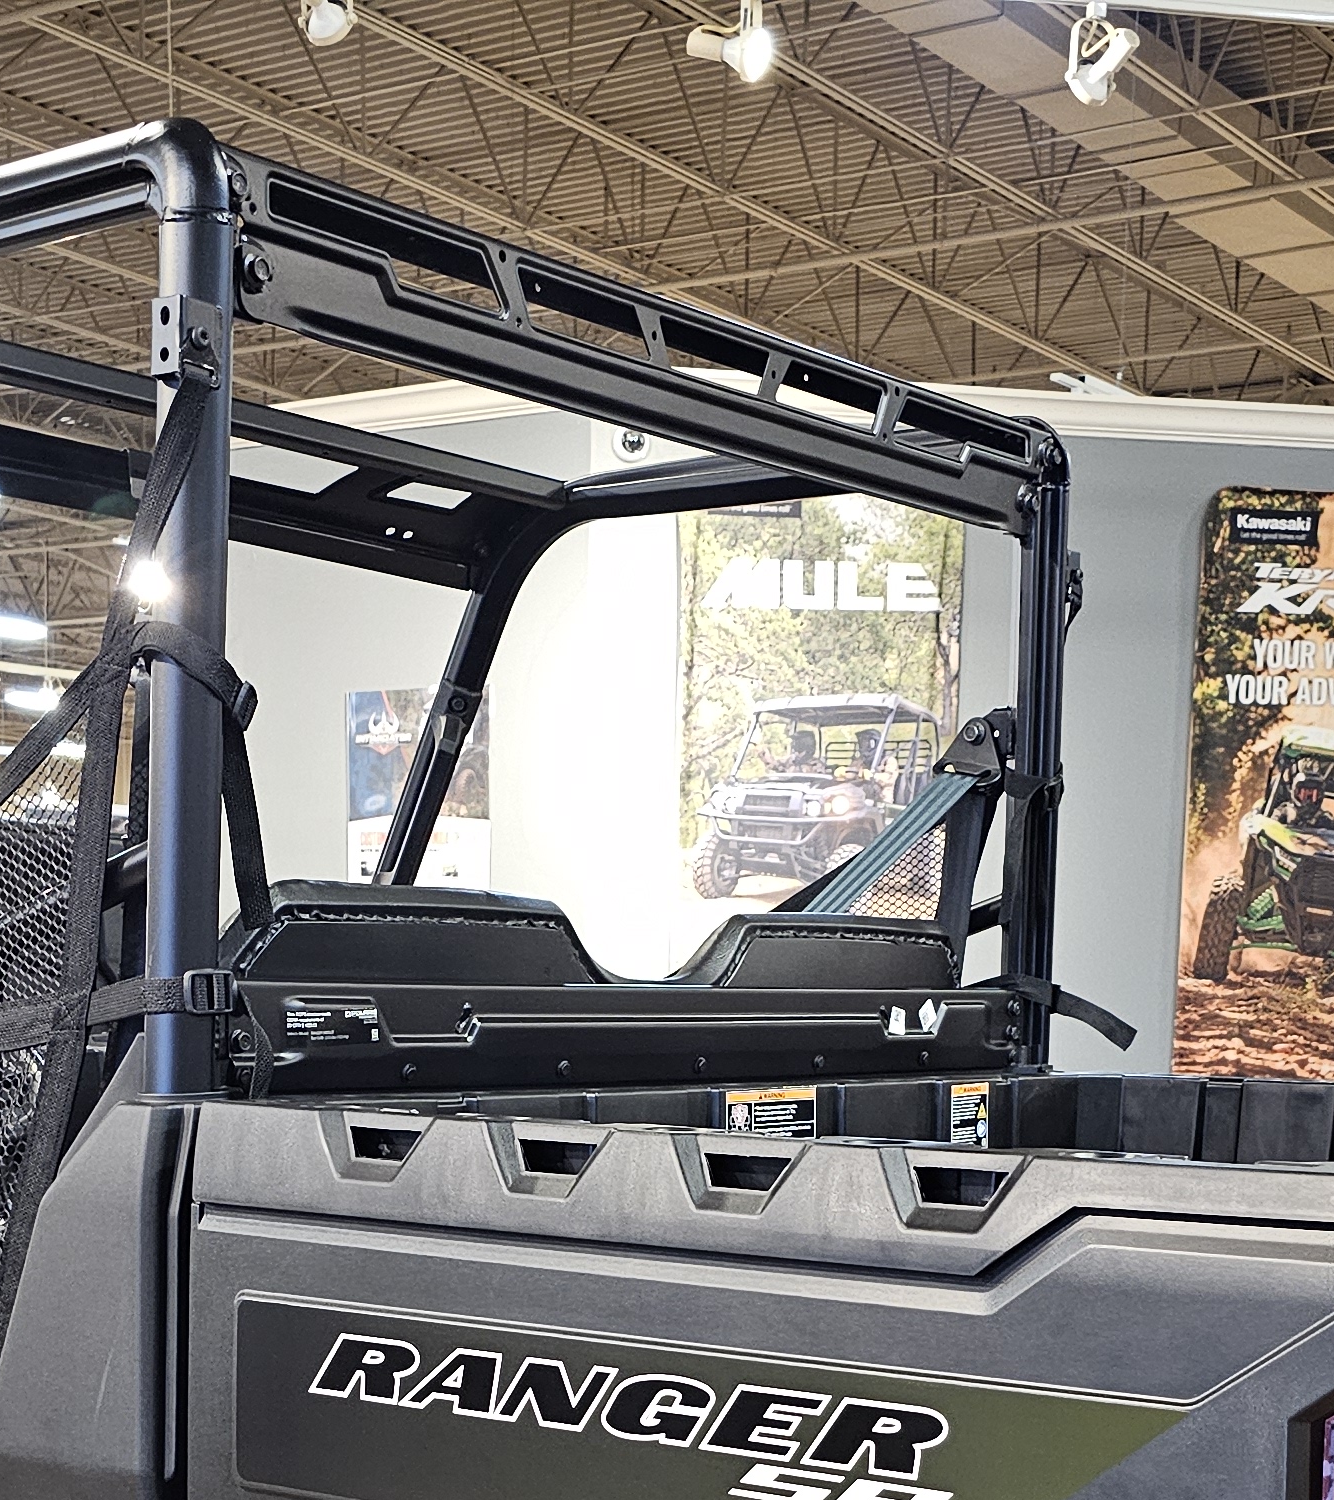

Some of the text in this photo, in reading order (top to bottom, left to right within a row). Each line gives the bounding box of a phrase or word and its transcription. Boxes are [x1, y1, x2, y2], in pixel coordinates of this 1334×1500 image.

[1237, 514, 1312, 531] Kawasaki
[700, 557, 942, 611] MULE
[1253, 639, 1315, 670] YOUR
[1226, 674, 1290, 705] YOUR
[308, 1332, 950, 1480] RANGER
